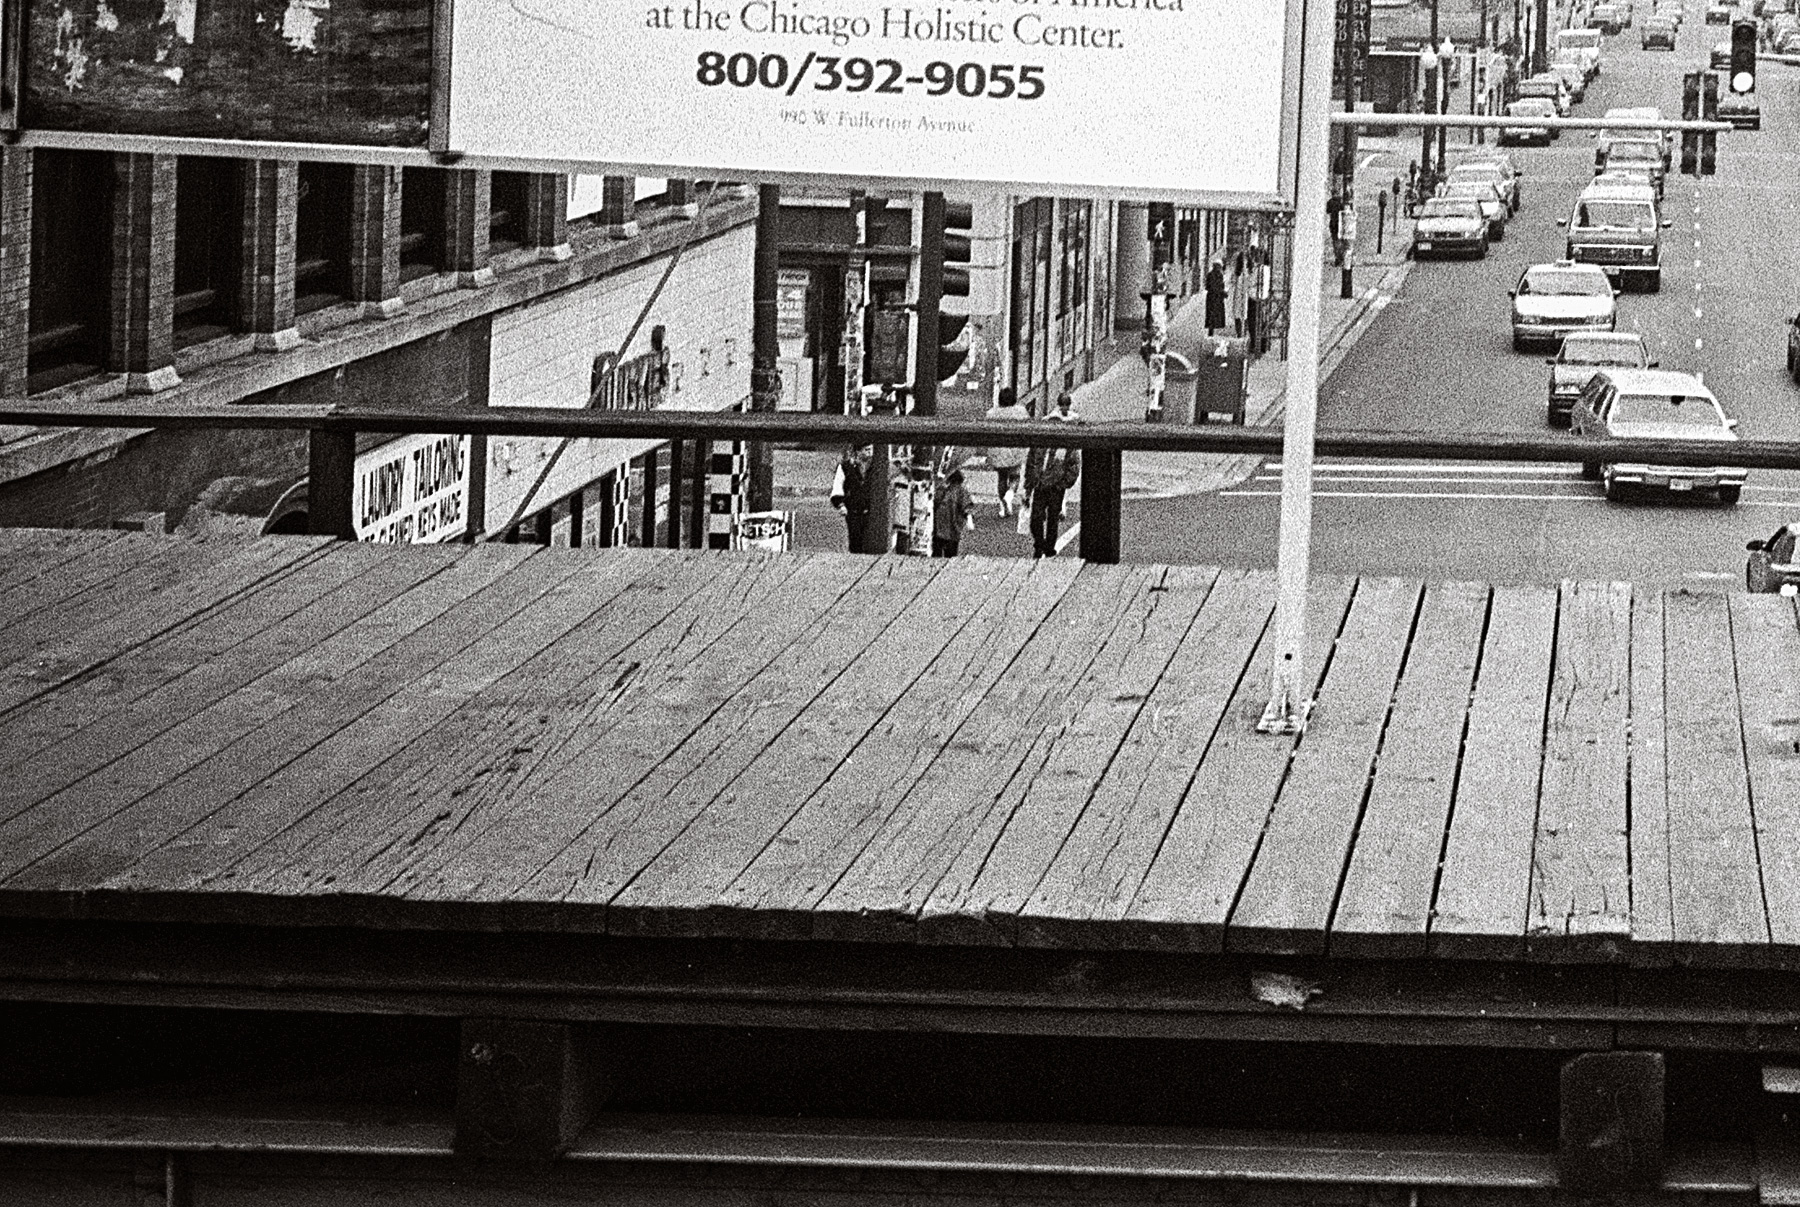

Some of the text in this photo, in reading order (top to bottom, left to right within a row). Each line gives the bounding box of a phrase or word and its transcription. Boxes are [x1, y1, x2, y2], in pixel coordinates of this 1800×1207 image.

[645, 6, 672, 29] at
[739, 0, 871, 45] Chicago
[882, 7, 1003, 43] Holistic
[1012, 14, 1124, 51] Center.
[696, 51, 1045, 100] 800/392-9055
[361, 434, 465, 529] LAUNDRY TAILORING
[417, 501, 438, 538] KEYS
[439, 489, 462, 528] MADE
